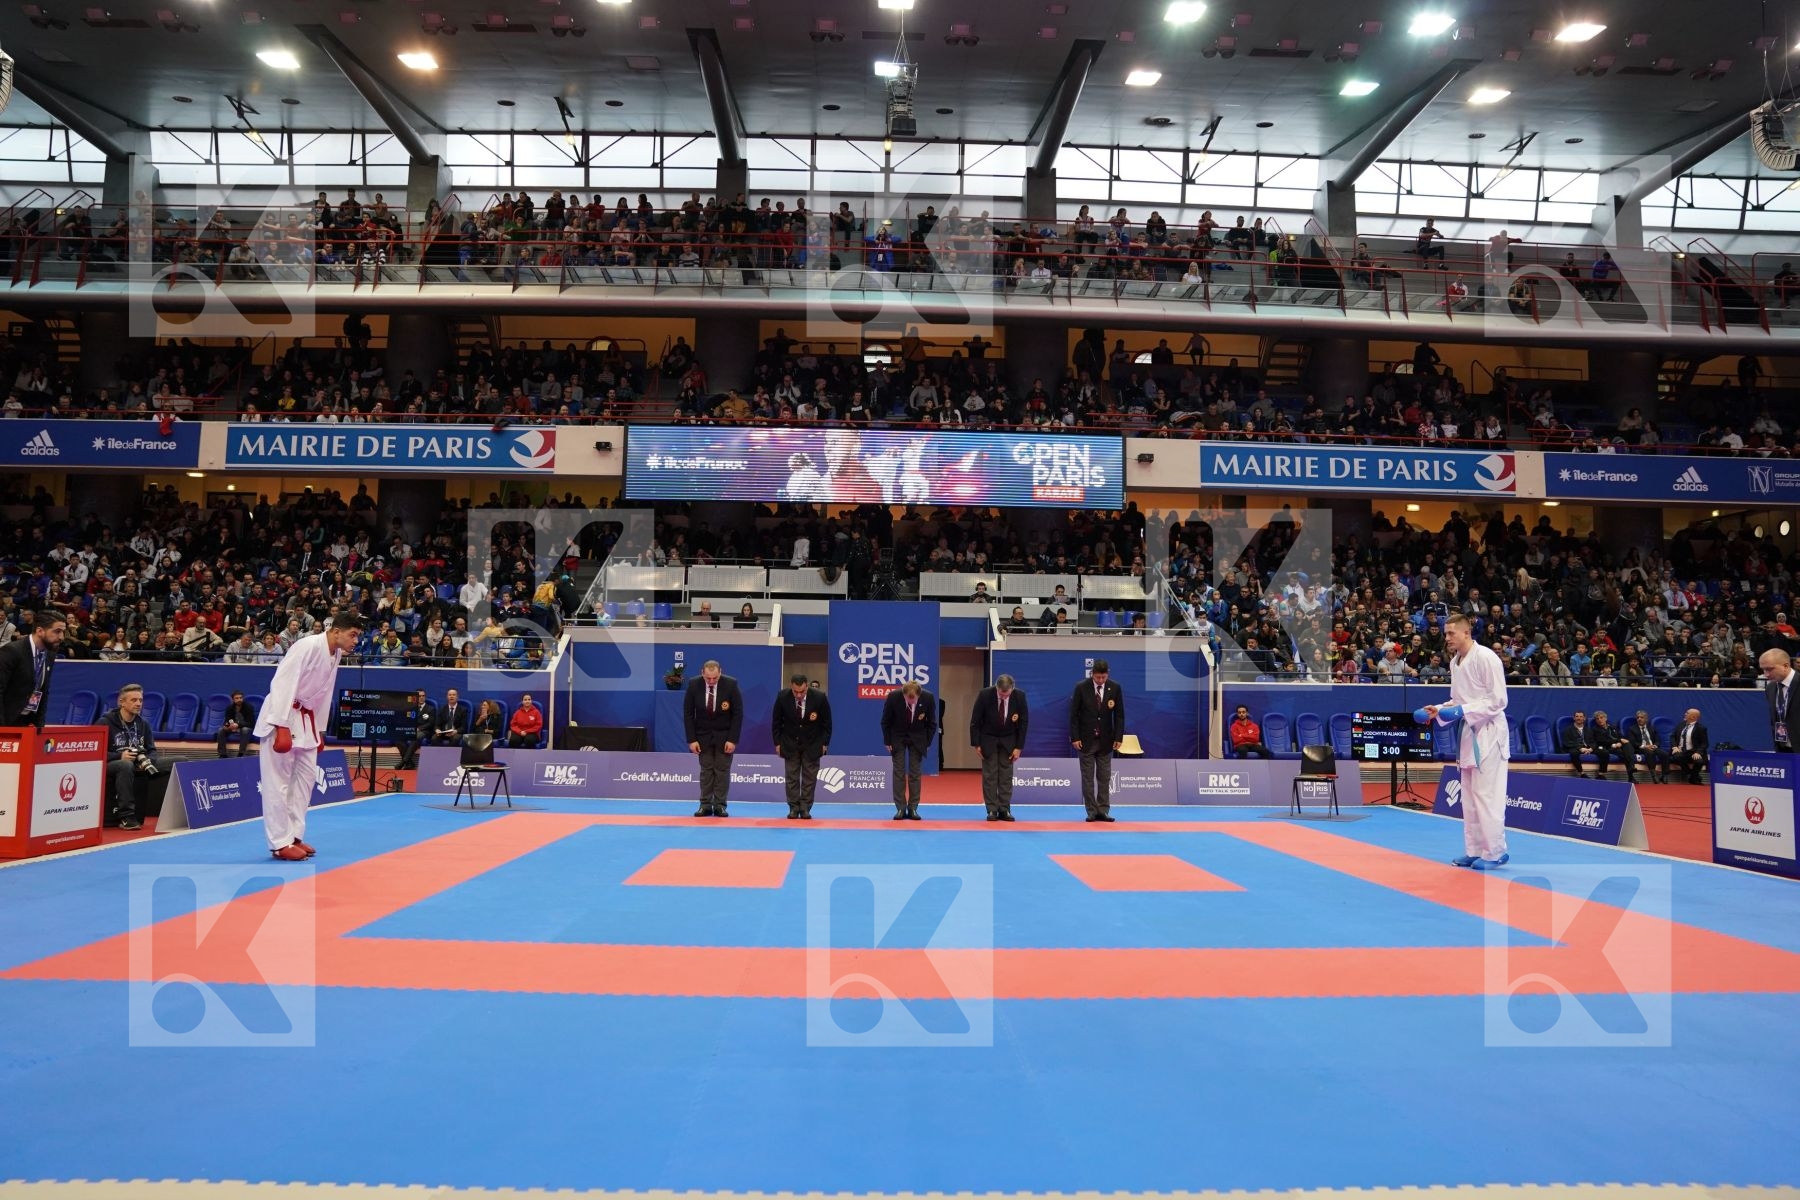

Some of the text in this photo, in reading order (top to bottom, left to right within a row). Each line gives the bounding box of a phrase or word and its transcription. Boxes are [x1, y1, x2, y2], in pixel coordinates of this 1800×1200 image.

[21, 446, 60, 456] adidas
[238, 434, 492, 459] MAIRIE DE PARIS
[1013, 443, 1090, 466] OPEN
[1213, 453, 1458, 482] MAIRIE DE PARIS
[1033, 465, 1106, 487] PARIS
[1672, 481, 1709, 492] adidas
[839, 642, 914, 665] OPEN
[858, 664, 930, 685] PARIS
[1382, 746, 1400, 755] 3:00
[544, 765, 579, 778] RMC
[620, 771, 692, 783] Crédit Mutuel
[730, 773, 786, 783] îledeFranc
[553, 776, 585, 785] SPORT
[1208, 774, 1240, 787] RMC
[63, 804, 89, 813] AIRLINES
[1571, 799, 1600, 817] RMC
[1576, 814, 1603, 828] SPORT
[1730, 826, 1781, 838] JAPAN AIRLINES
